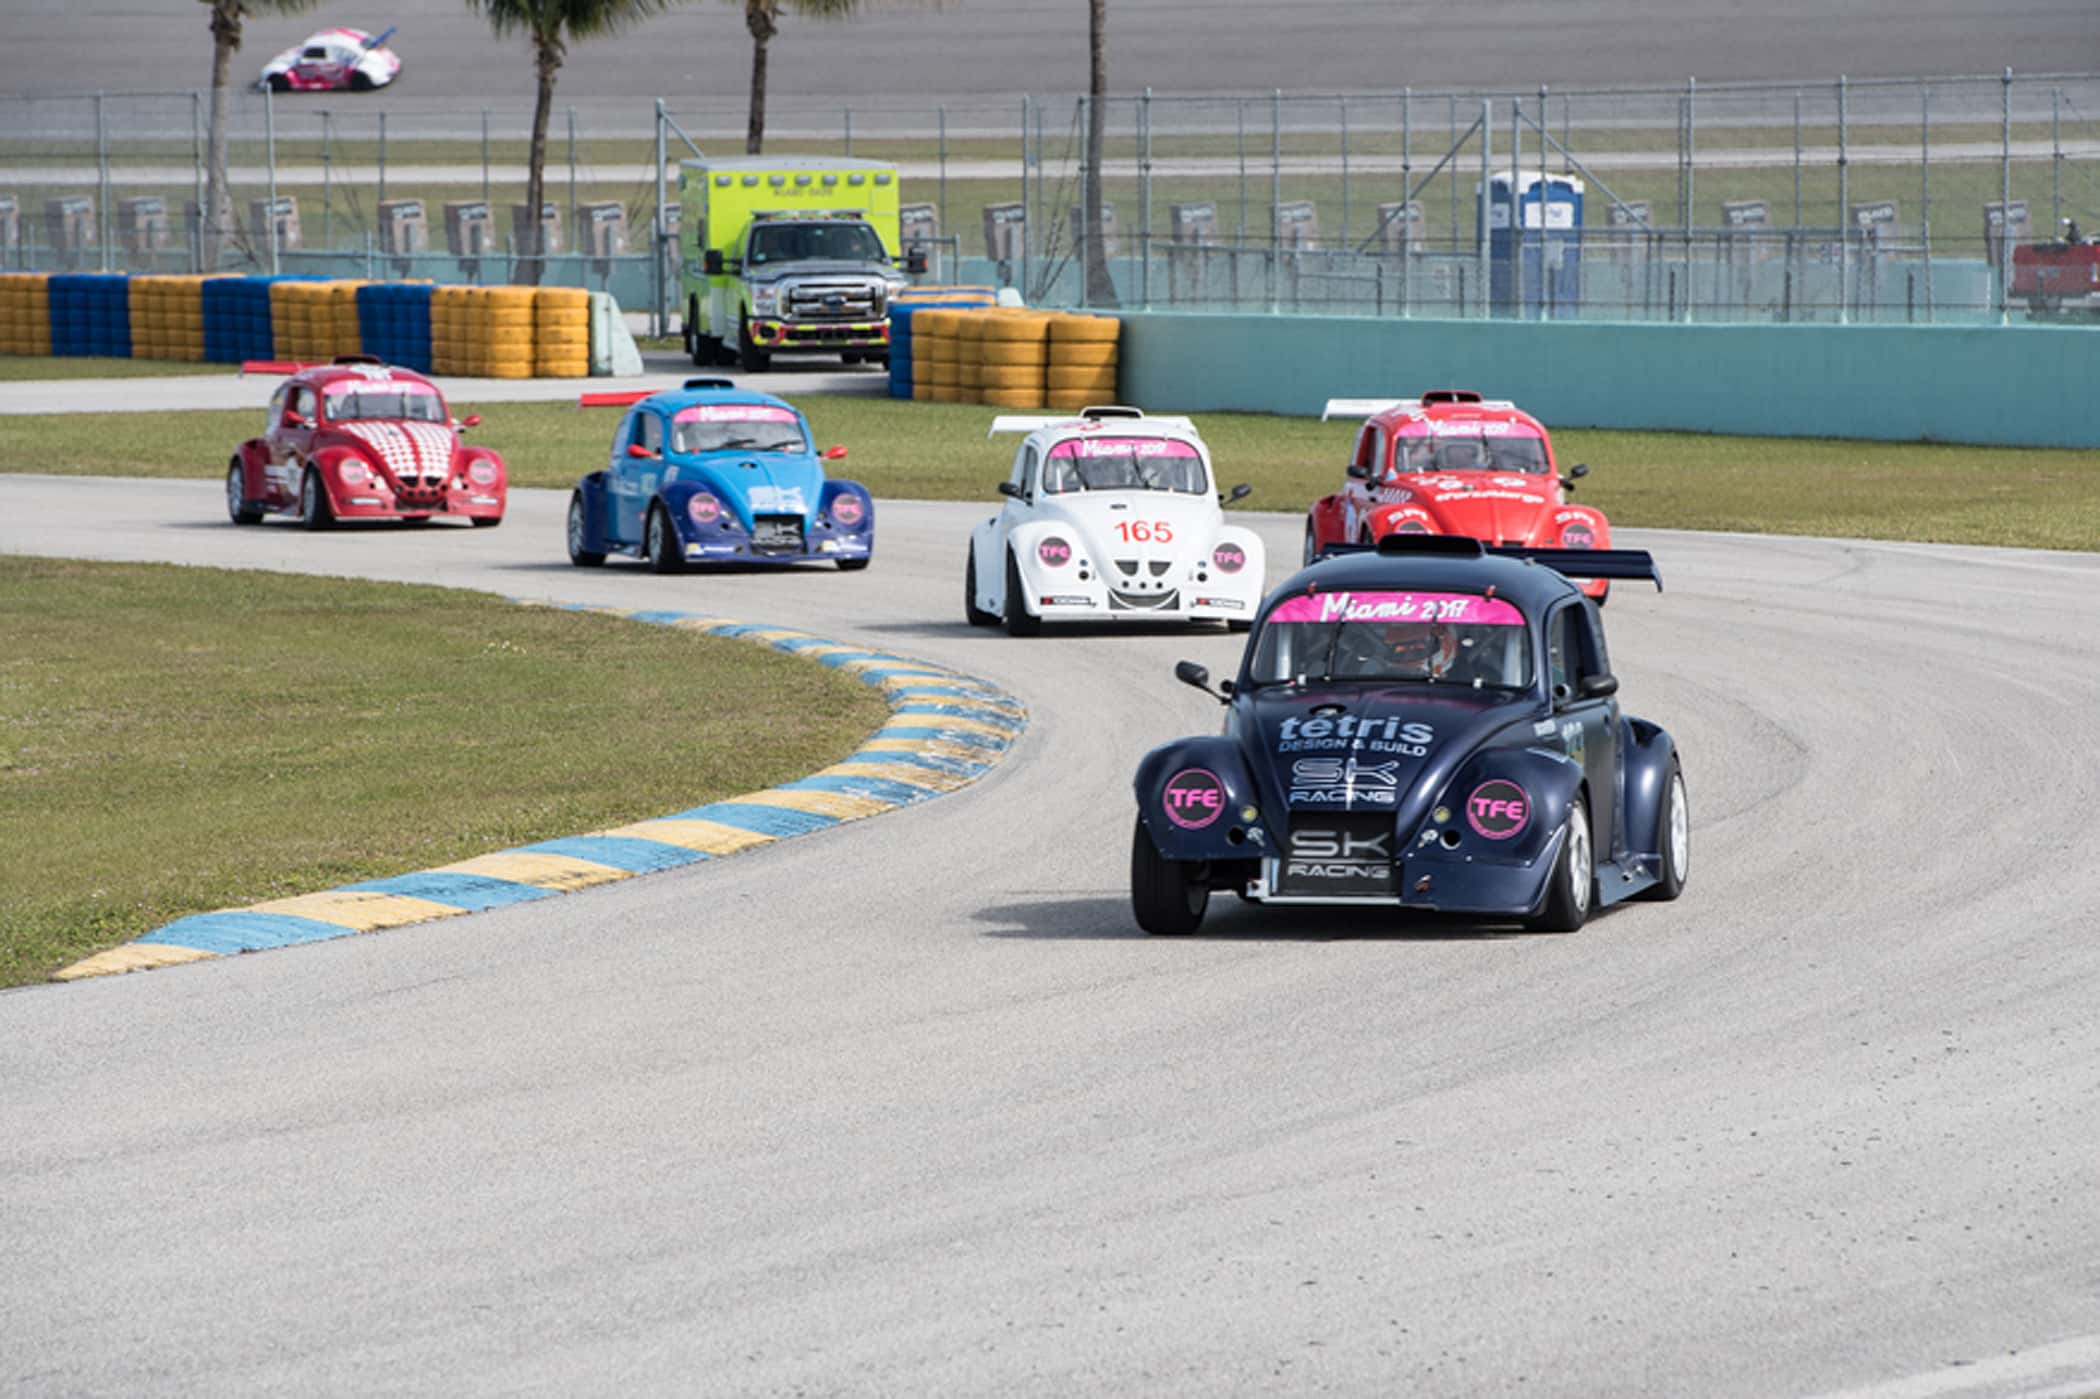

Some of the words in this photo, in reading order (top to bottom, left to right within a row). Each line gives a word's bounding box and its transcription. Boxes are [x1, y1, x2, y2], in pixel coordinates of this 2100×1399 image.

[1083, 439, 1133, 457] Miami
[1115, 520, 1173, 543] 165
[1040, 544, 1069, 559] TFE
[1215, 551, 1243, 565] TFE
[1320, 592, 1417, 622] Miami
[1419, 599, 1469, 620] 2017
[1279, 738, 1349, 752] DESIGN
[1370, 741, 1427, 757] BUILD
[1292, 757, 1400, 785] SK
[1168, 788, 1219, 808] TFE
[1289, 791, 1396, 804] RACING
[1473, 798, 1524, 820] TFE
[1290, 829, 1390, 857] SK
[1287, 864, 1390, 879] RACING
